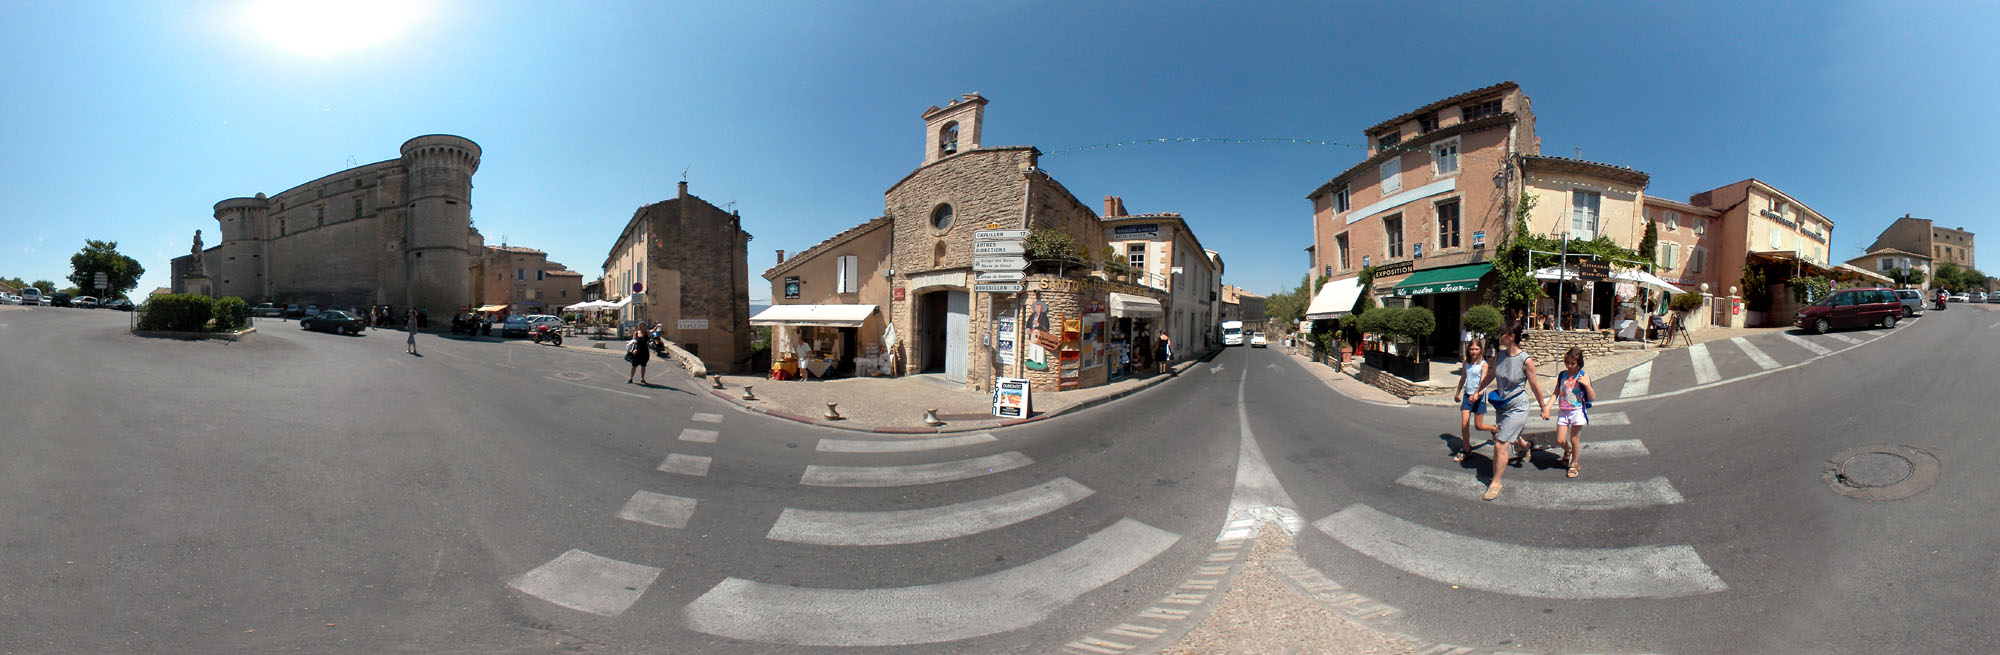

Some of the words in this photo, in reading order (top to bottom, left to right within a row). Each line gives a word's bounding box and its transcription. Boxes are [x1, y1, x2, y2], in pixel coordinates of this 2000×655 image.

[1375, 265, 1413, 278] EXPOSITION
[1041, 277, 1088, 293] SANTONS
[1412, 287, 1433, 295] autre
